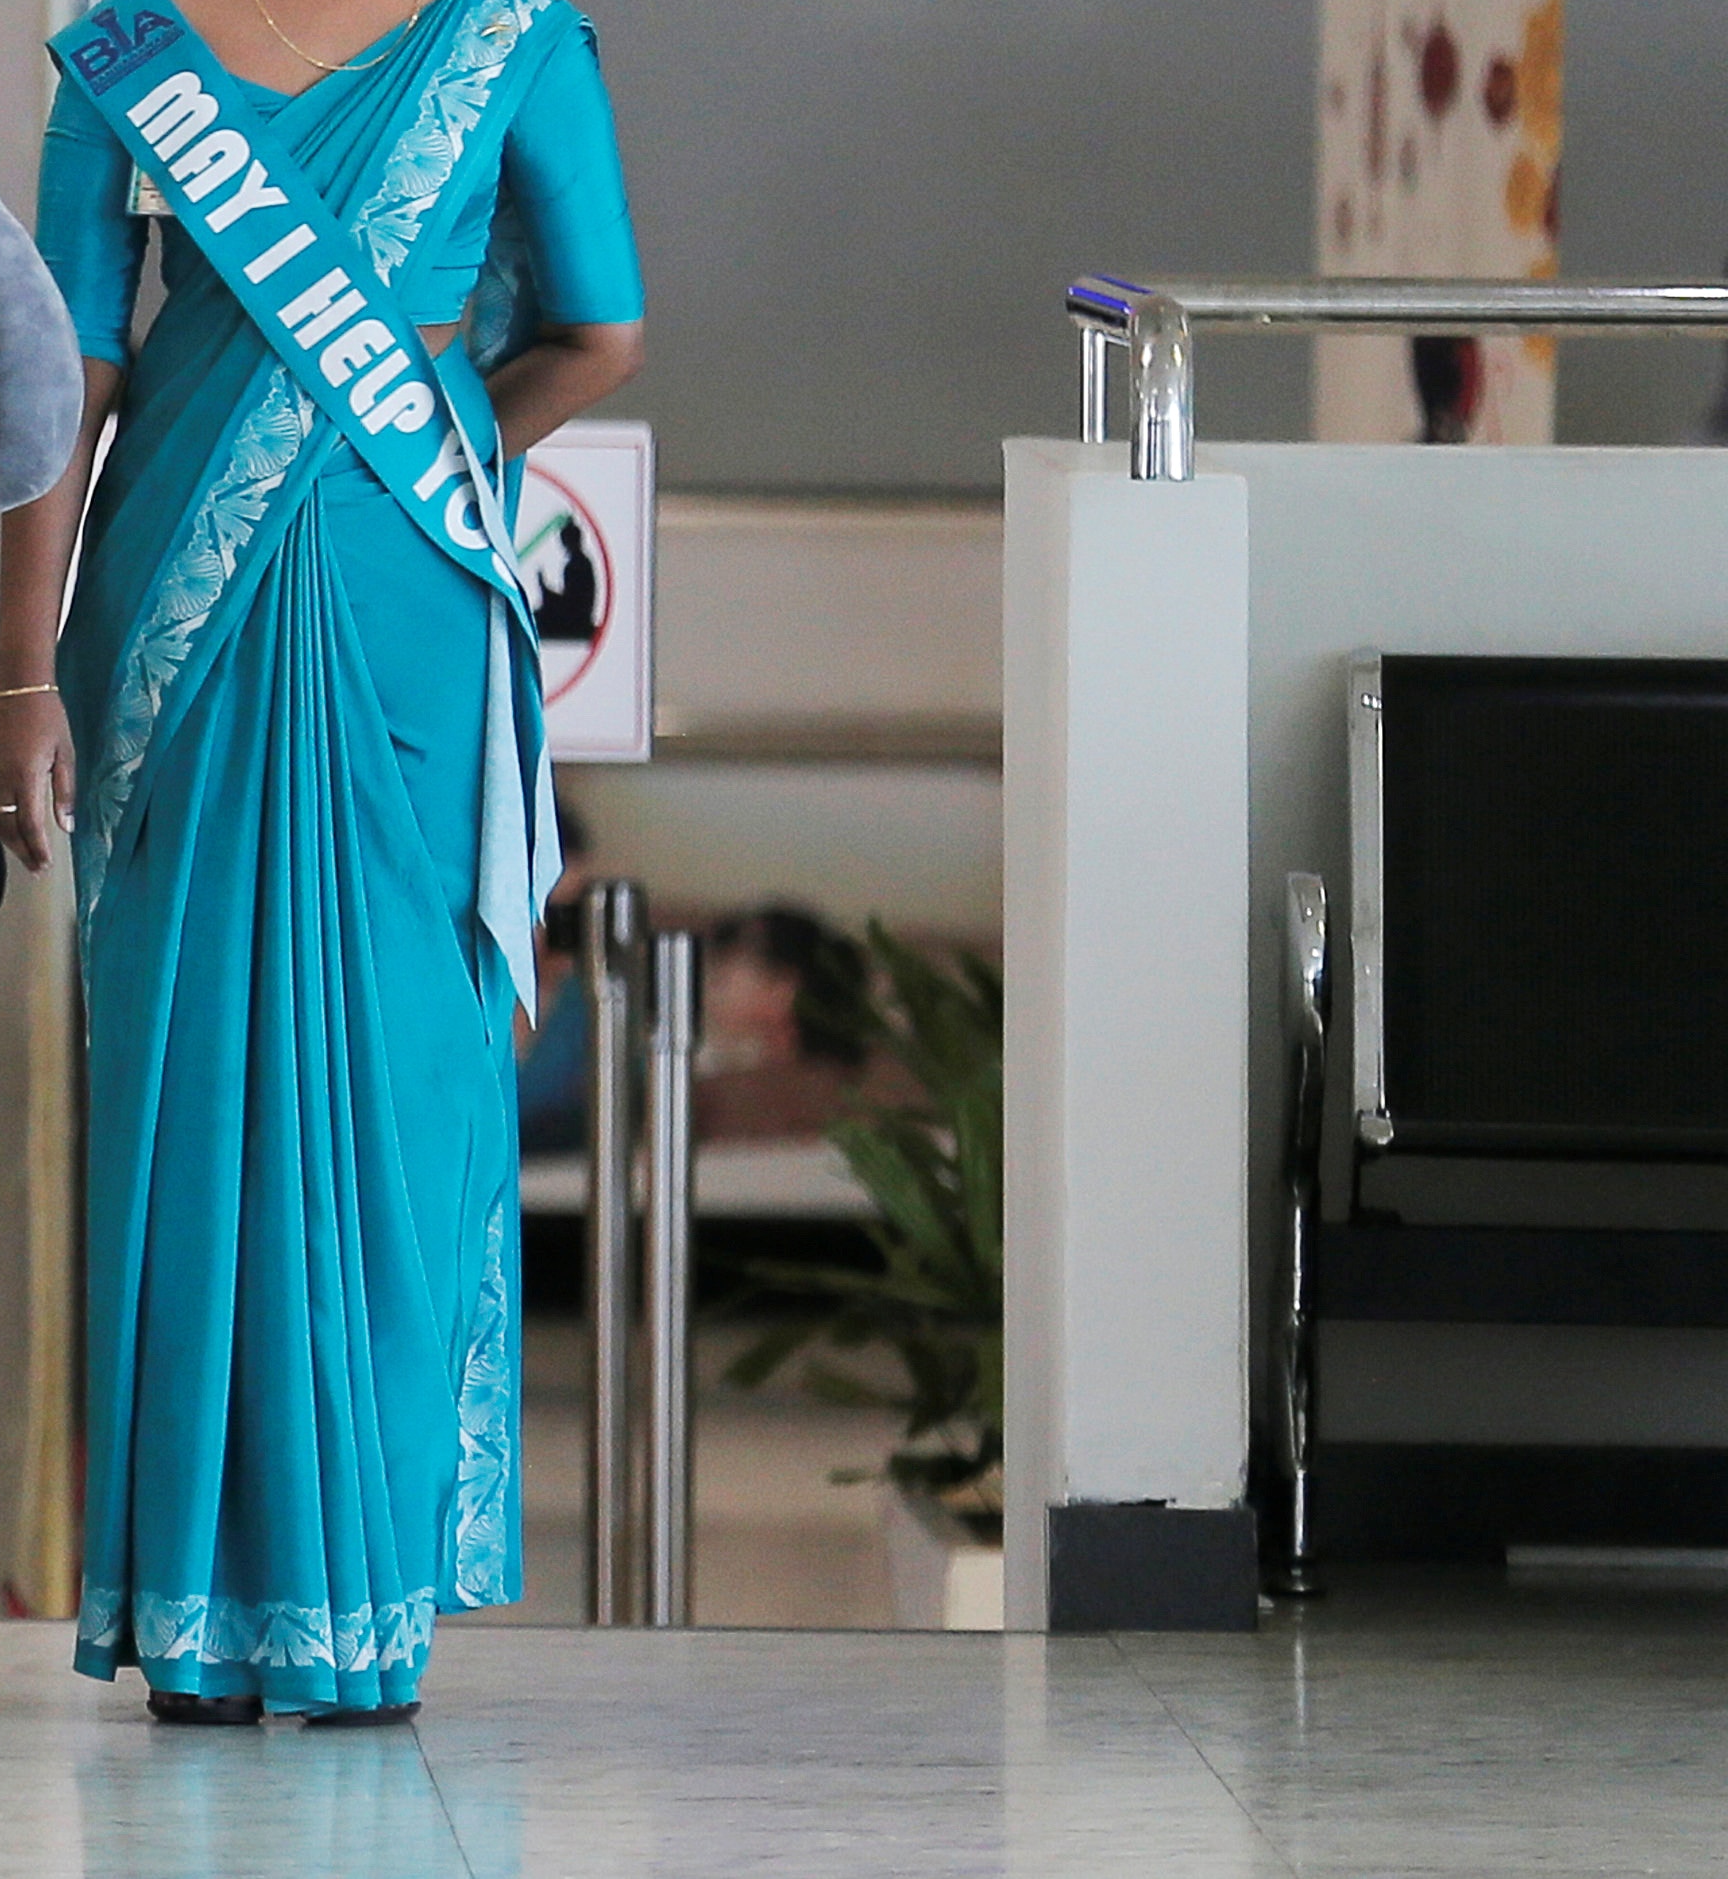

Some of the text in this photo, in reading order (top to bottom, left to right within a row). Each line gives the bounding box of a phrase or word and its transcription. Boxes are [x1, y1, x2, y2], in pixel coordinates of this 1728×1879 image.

[70, 7, 175, 82] BIA
[127, 71, 288, 234] MAY
[243, 223, 318, 285] I
[277, 267, 435, 436] HELP
[412, 429, 518, 590] YO
